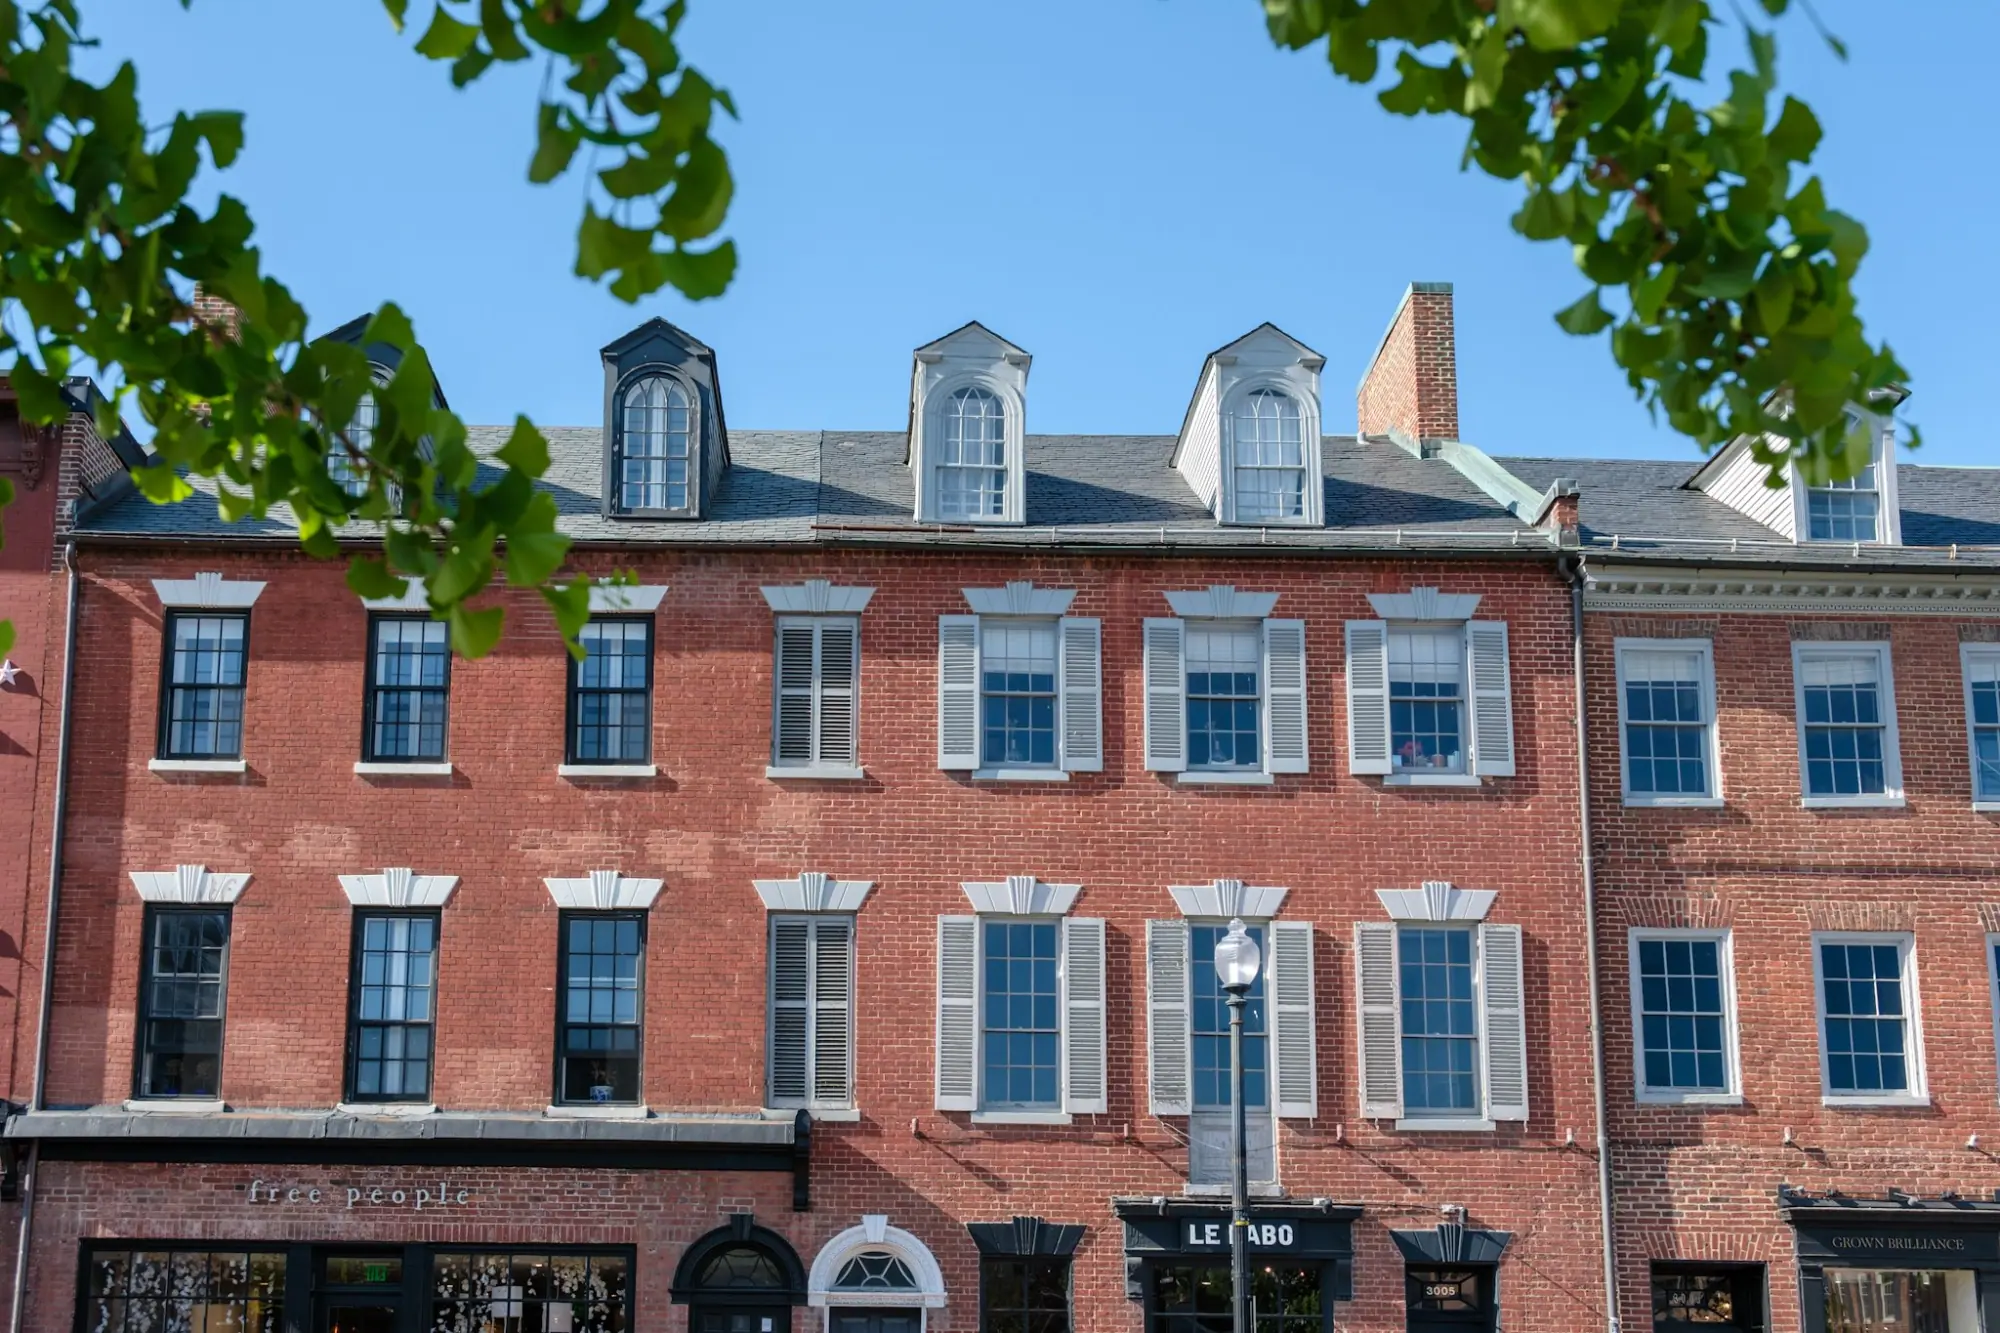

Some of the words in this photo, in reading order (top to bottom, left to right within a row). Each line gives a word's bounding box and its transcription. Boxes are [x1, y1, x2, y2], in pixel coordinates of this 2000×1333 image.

[249, 1180, 322, 1203] free
[346, 1183, 469, 1211] people
[1189, 1224, 1221, 1245] LE
[1832, 1236, 1884, 1249] GROWN
[1888, 1237, 1965, 1250] BRILLIANCE
[1426, 1286, 1456, 1296] 3005
